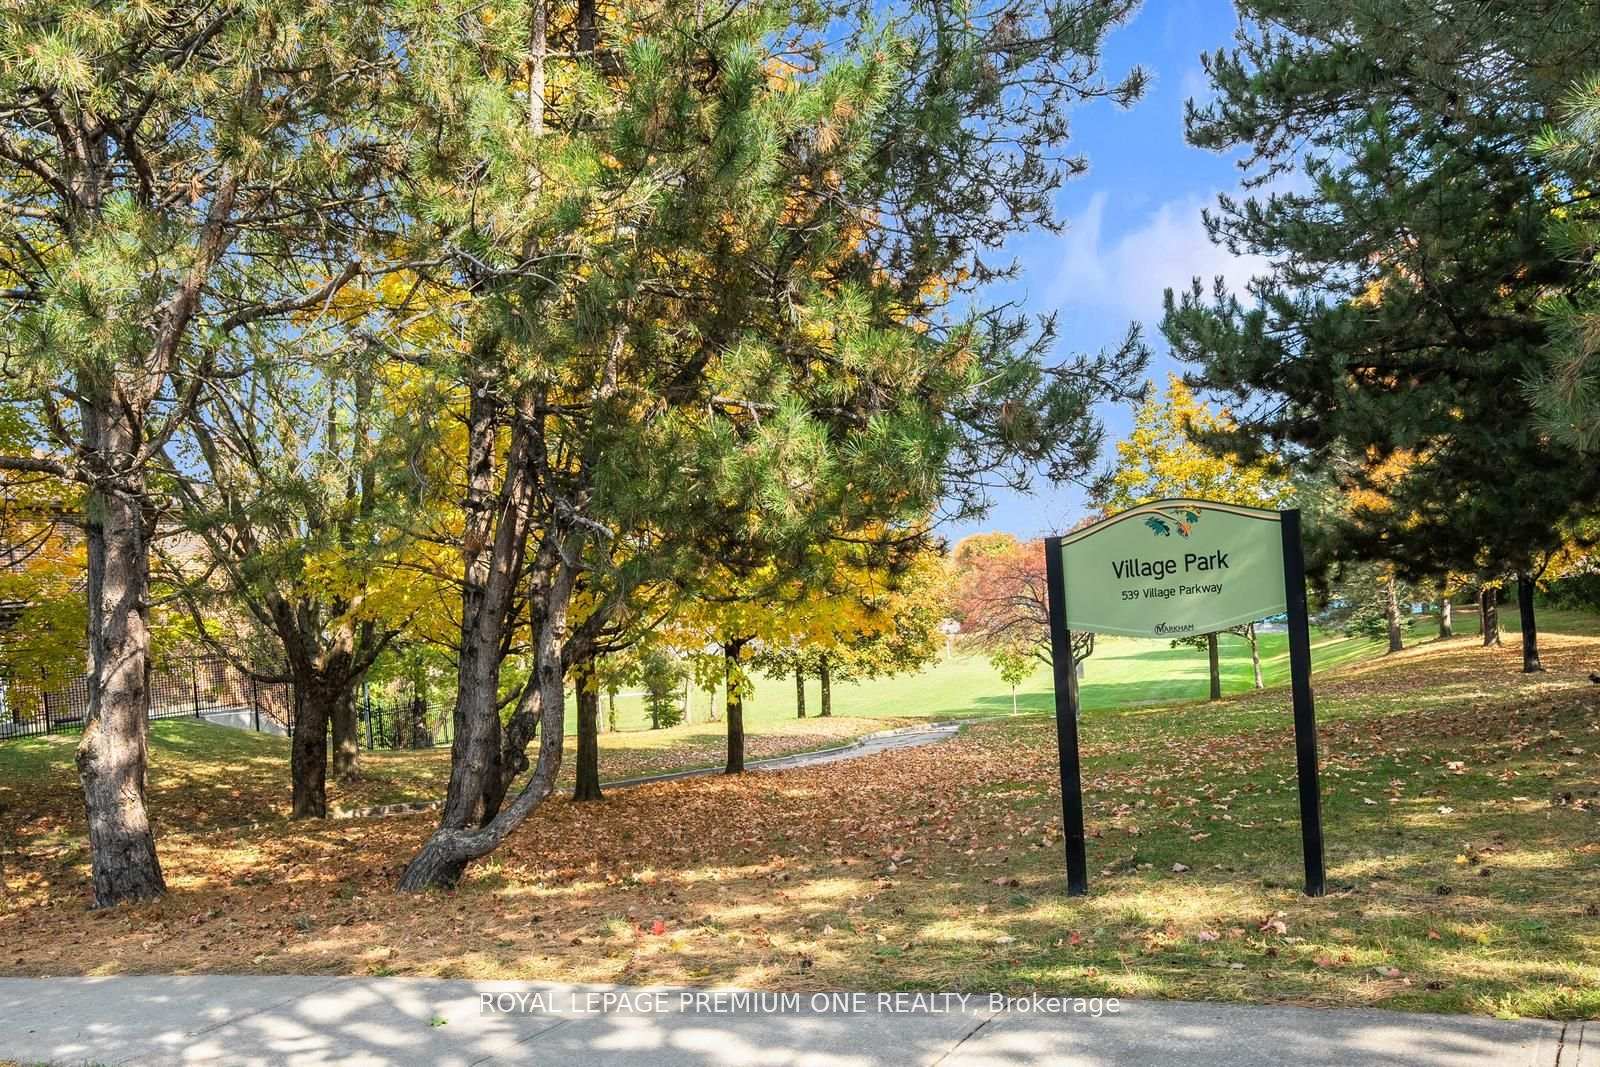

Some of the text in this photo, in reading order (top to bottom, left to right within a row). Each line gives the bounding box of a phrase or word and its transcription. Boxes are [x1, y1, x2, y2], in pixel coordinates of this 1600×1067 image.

[1112, 550, 1229, 580] Village Park
[1121, 583, 1222, 600] 539 Village Parkway
[1154, 622, 1194, 634] MARKHAM
